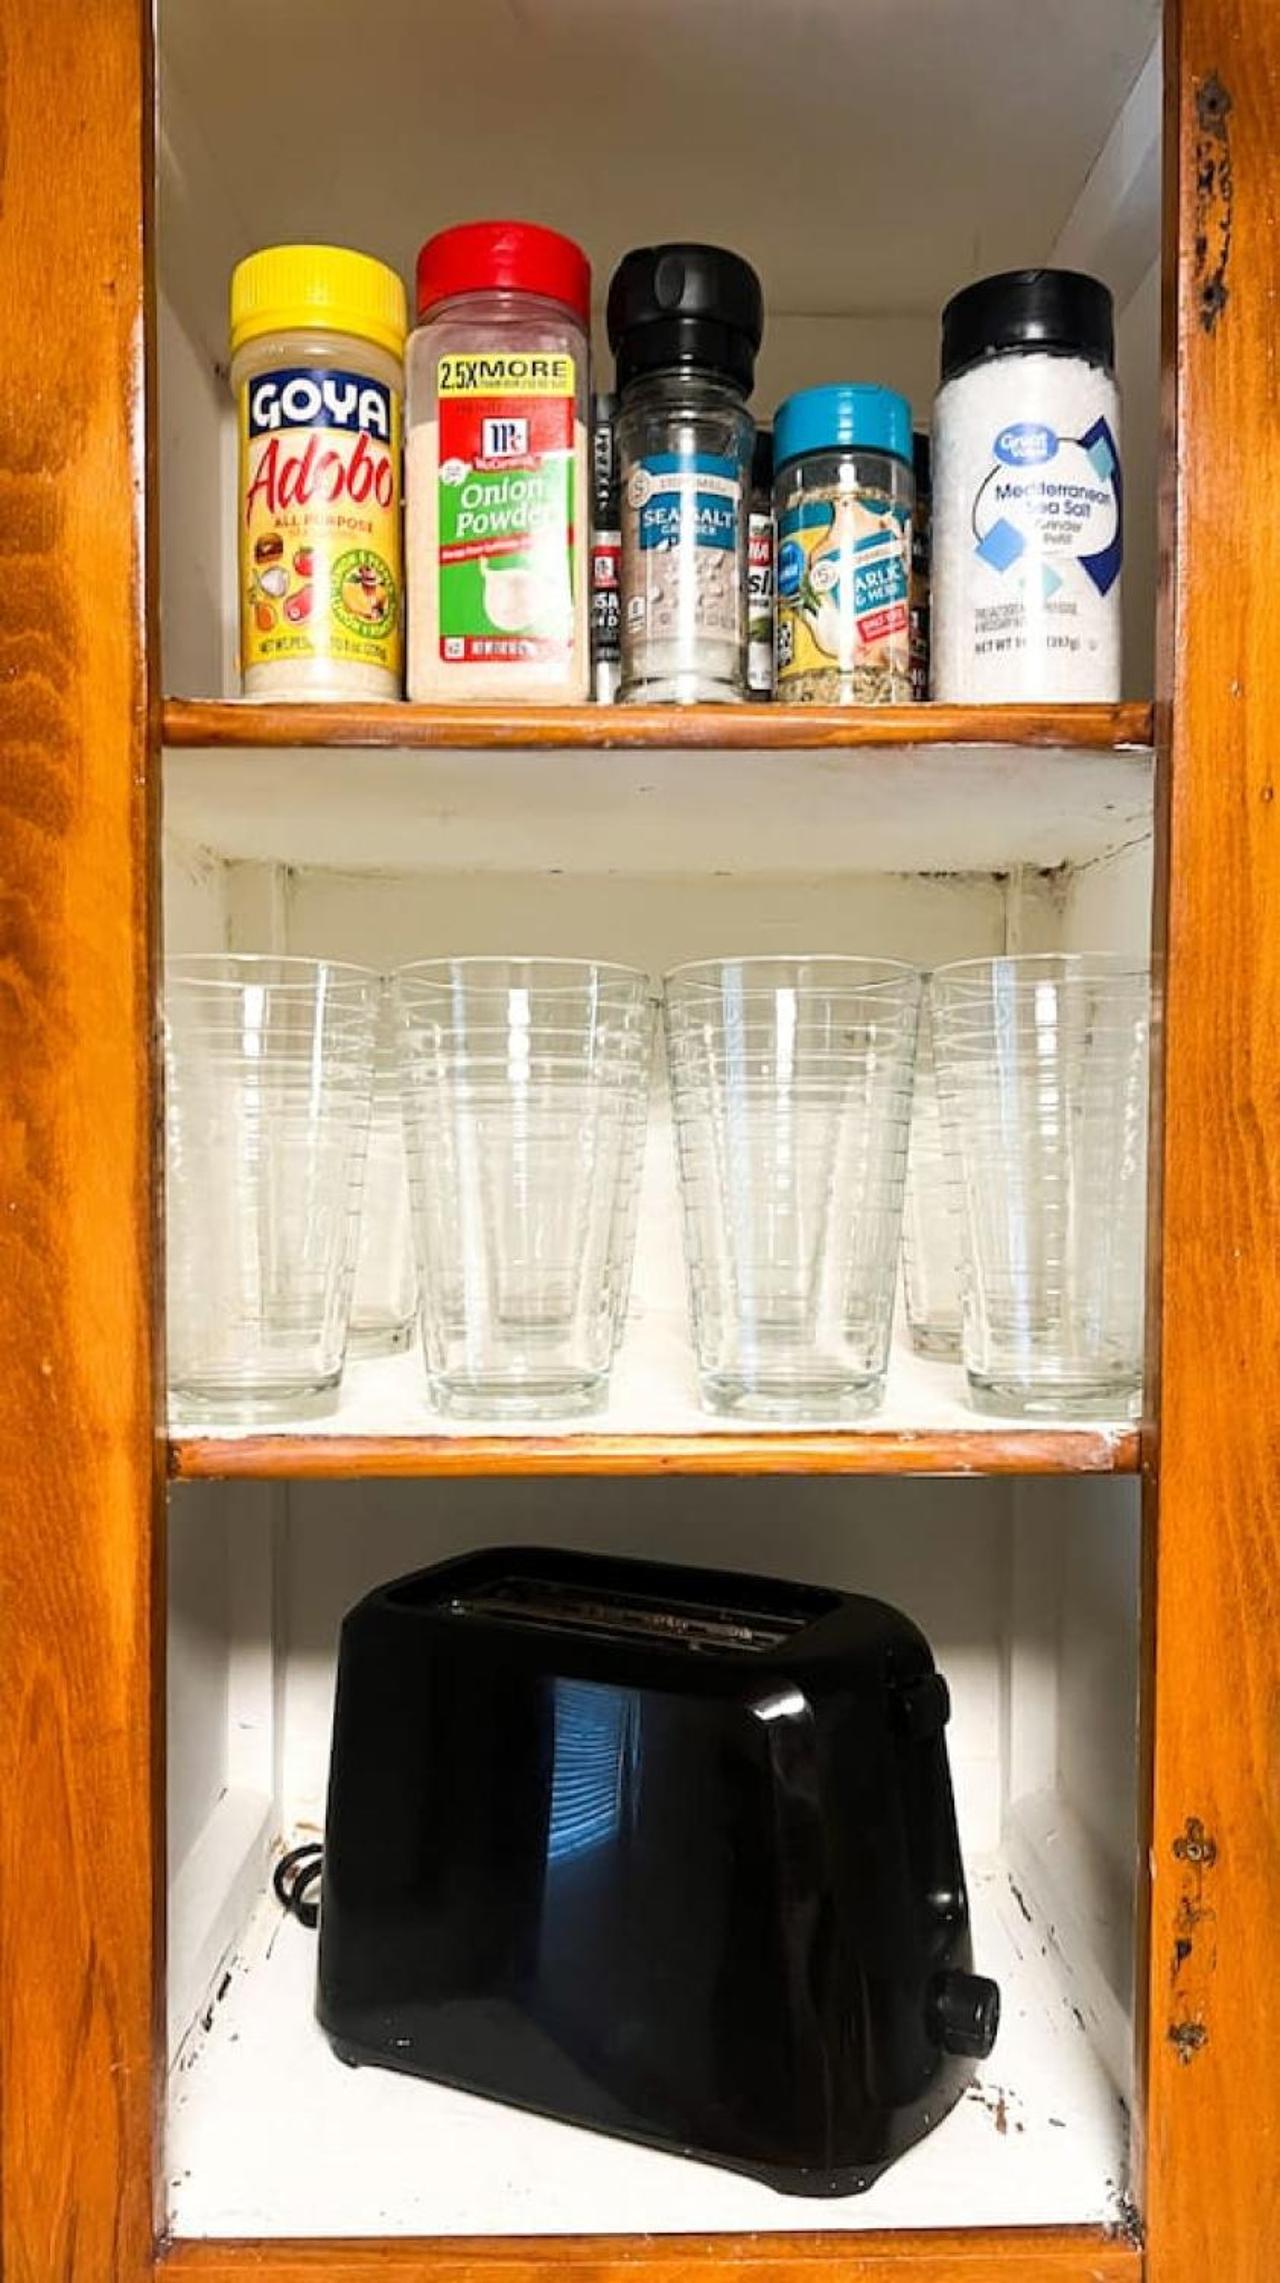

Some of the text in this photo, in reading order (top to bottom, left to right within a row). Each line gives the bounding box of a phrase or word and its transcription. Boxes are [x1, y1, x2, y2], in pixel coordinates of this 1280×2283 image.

[480, 361, 568, 377] MORE
[252, 378, 387, 437] GOYA
[245, 432, 394, 529] Adobo
[461, 476, 545, 509] Onion
[456, 504, 557, 538] Powde
[643, 507, 682, 528] SEA
[1063, 499, 1092, 518] Salt
